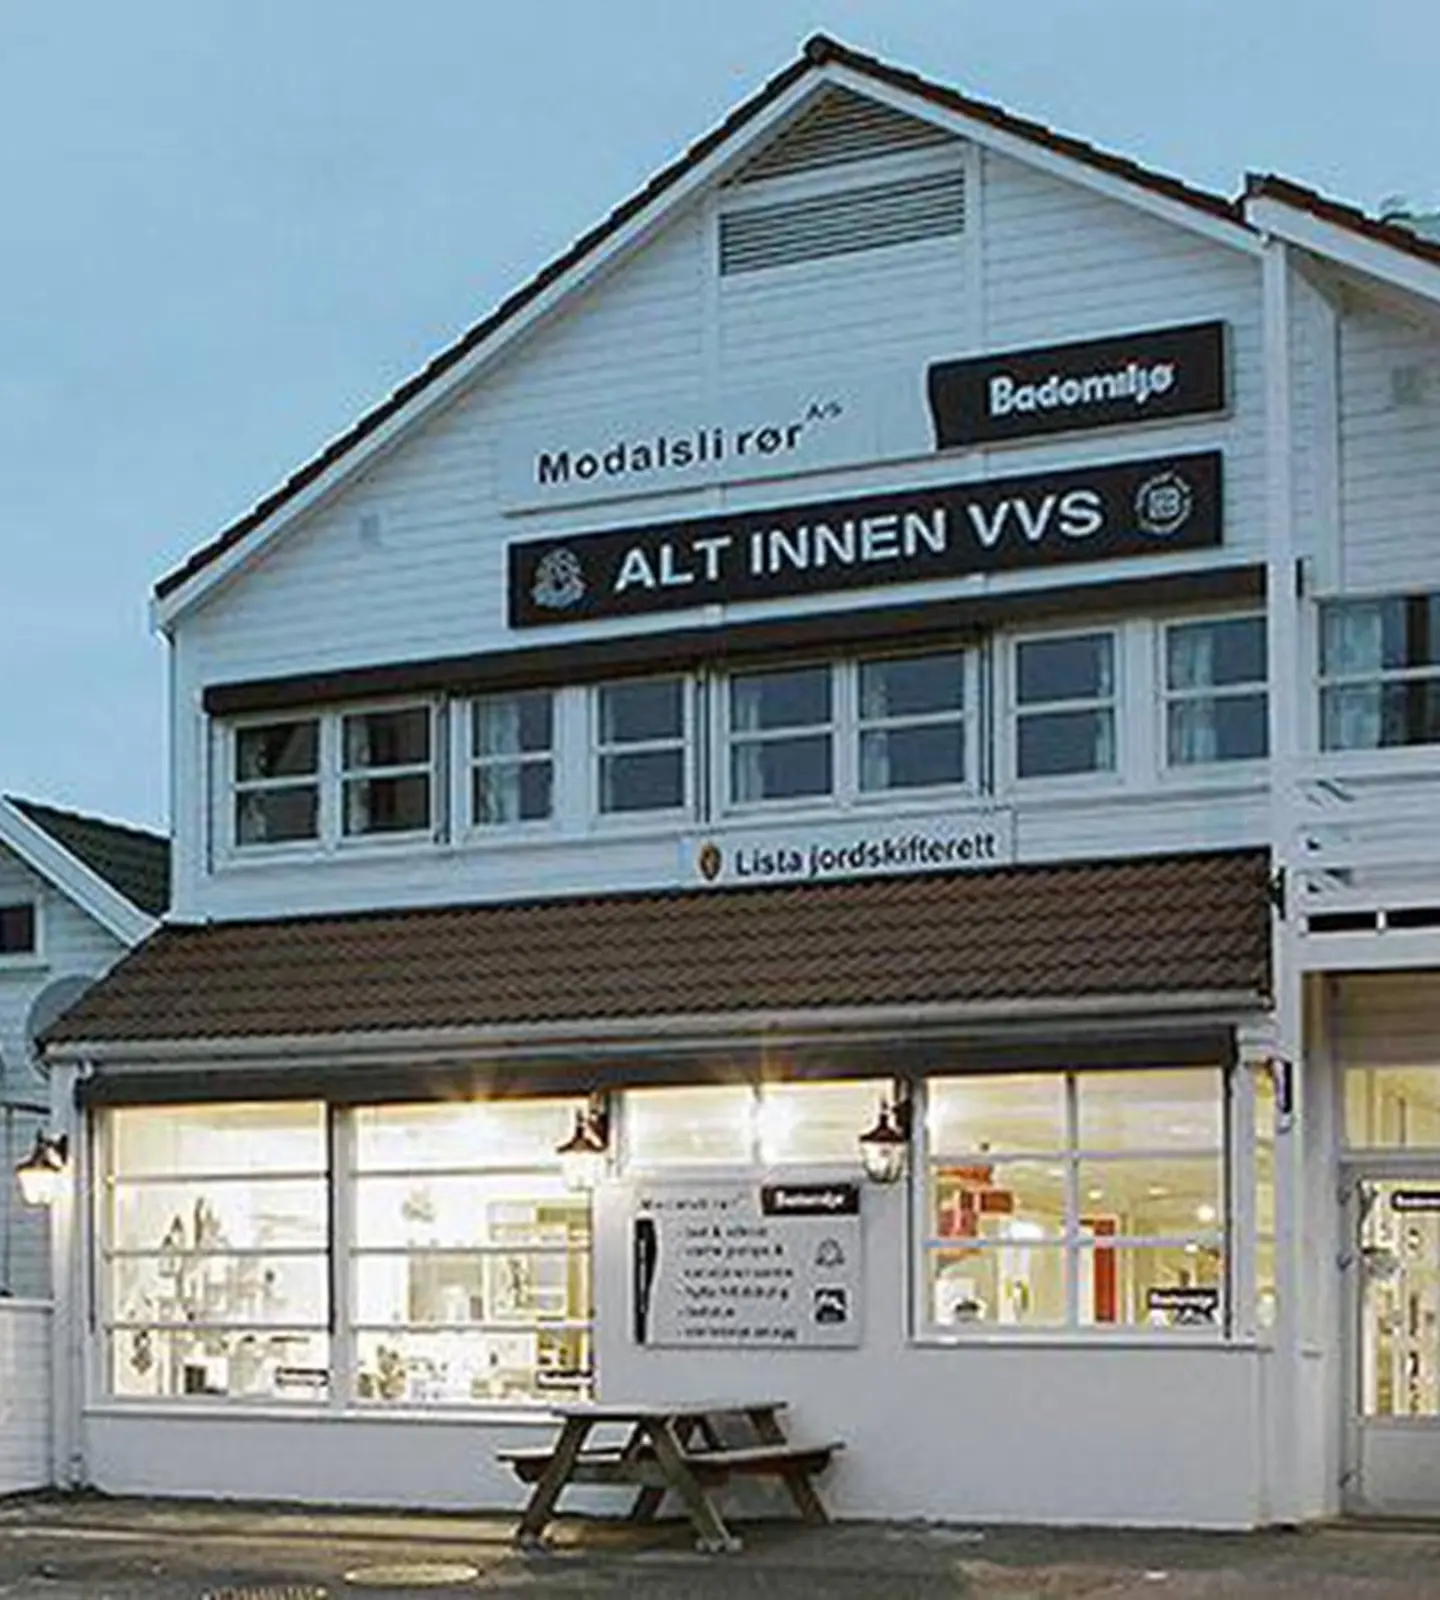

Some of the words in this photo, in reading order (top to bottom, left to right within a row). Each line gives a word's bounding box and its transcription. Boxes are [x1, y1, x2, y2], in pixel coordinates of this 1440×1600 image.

[538, 428, 724, 484] Modalsli
[736, 424, 804, 455] rør
[614, 537, 731, 591] ALT
[749, 507, 947, 575] INNEN
[967, 490, 1104, 547] VVS
[735, 848, 803, 876] Lista
[808, 832, 997, 878] jordskifterett
